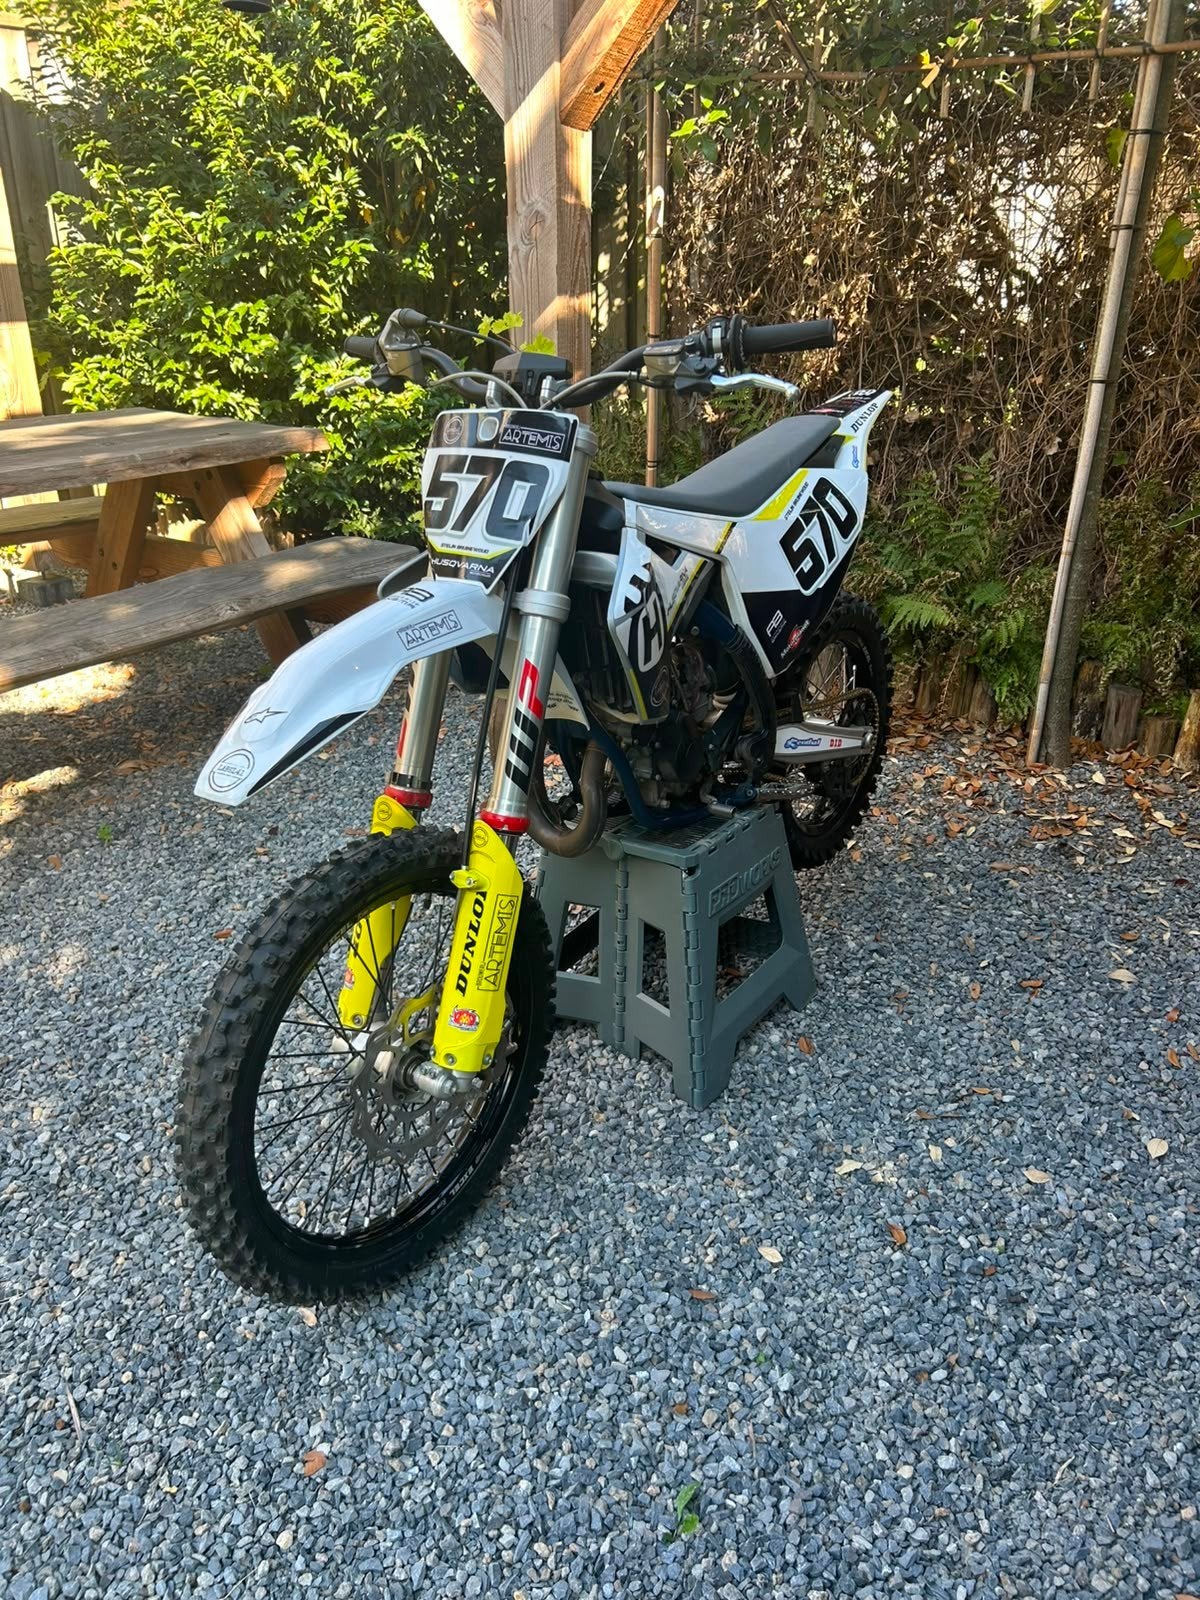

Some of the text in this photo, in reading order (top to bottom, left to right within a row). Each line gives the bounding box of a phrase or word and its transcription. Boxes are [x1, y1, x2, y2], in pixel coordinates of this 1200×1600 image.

[850, 402, 879, 433] DUNLOP
[502, 428, 562, 450] ARTEMIS
[424, 454, 550, 542] 570
[779, 476, 859, 592] 570
[432, 558, 495, 574] HUSQVARNA
[404, 613, 459, 647] ARTEMIS
[483, 899, 515, 987] ARTEMIS
